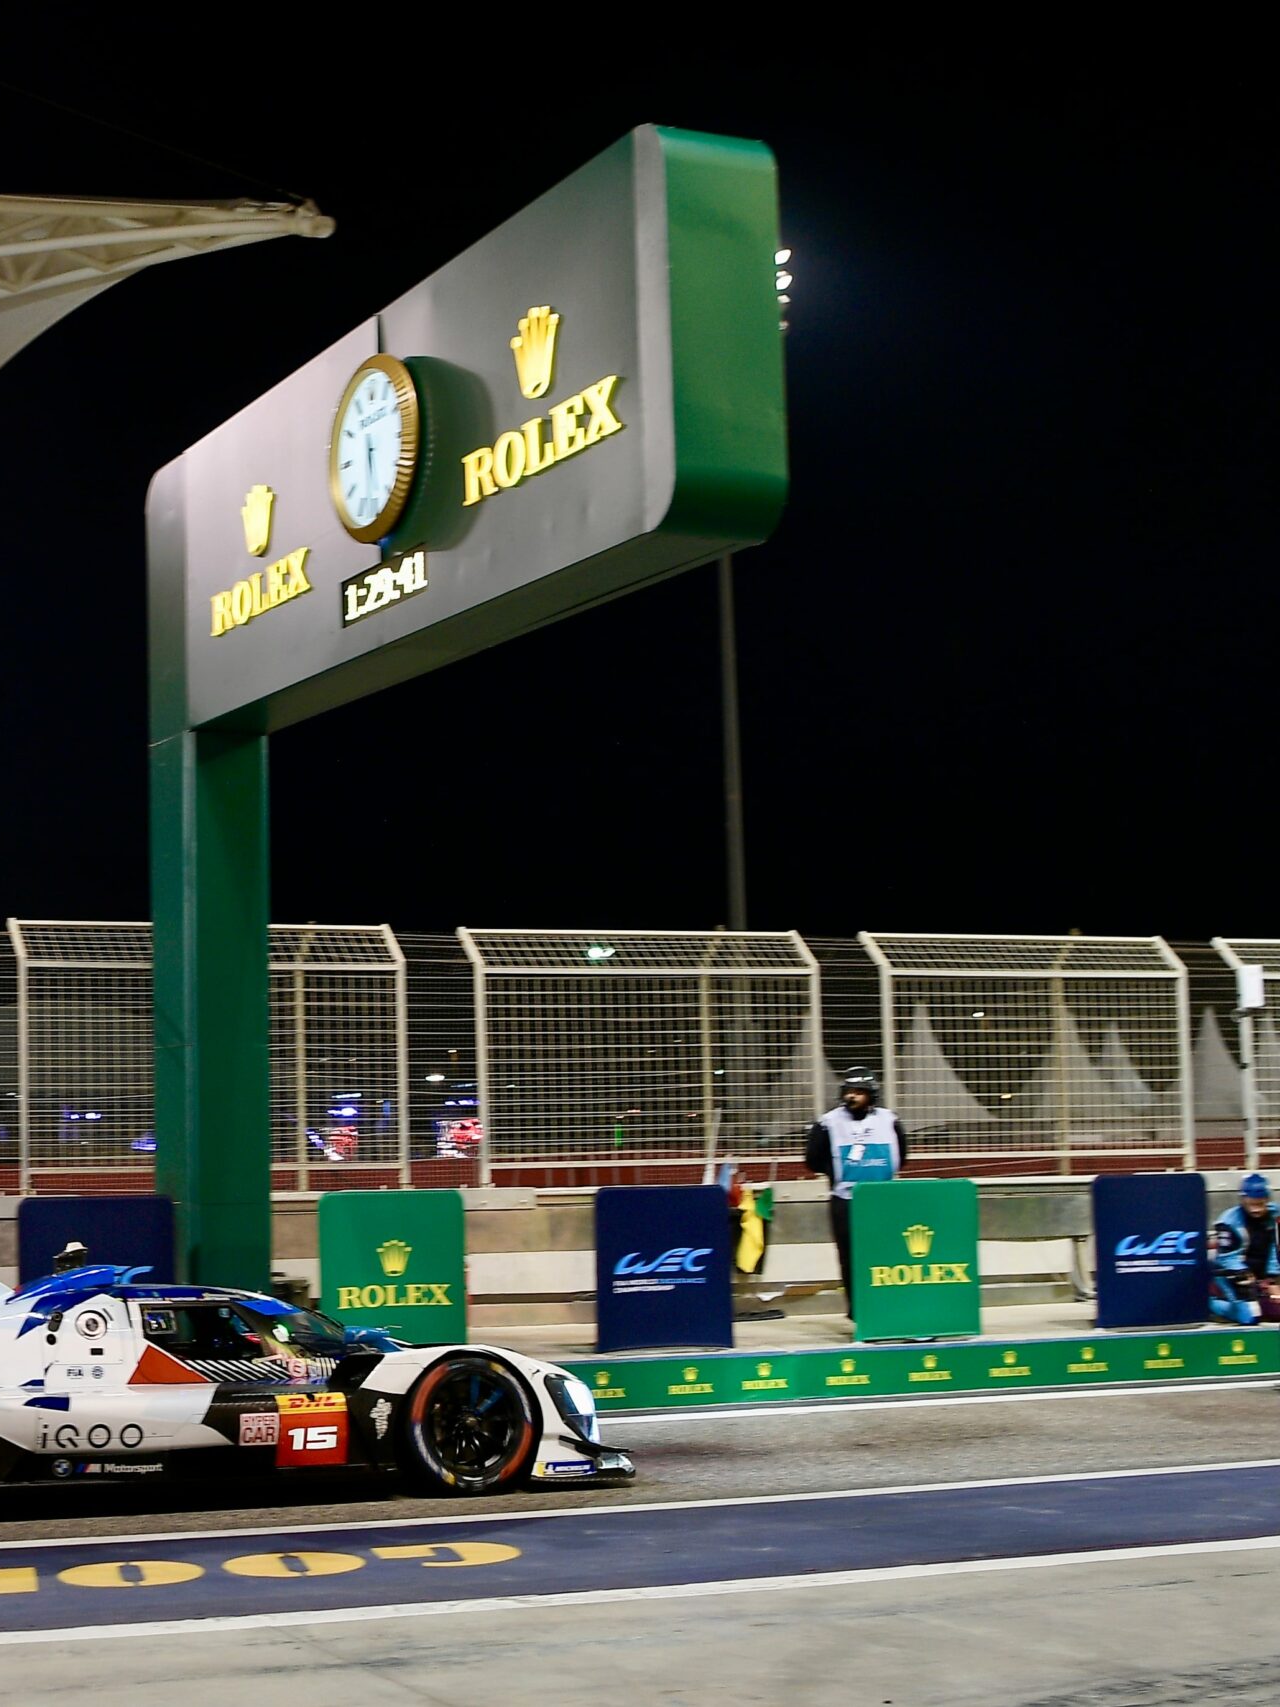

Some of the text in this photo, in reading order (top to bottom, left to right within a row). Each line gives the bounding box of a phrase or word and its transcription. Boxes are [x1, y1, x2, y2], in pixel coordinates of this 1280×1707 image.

[461, 374, 622, 506] ROLEX
[210, 547, 311, 636] ROLEX
[1114, 1230, 1200, 1256] WEC
[613, 1247, 714, 1275] WEC
[869, 1263, 972, 1287] ROLEX
[336, 1284, 454, 1309] ROLEX
[41, 1423, 144, 1449] iQOO
[242, 1426, 276, 1444] CAR
[288, 1425, 338, 1451] 15
[104, 1463, 163, 1475] Motorsport
